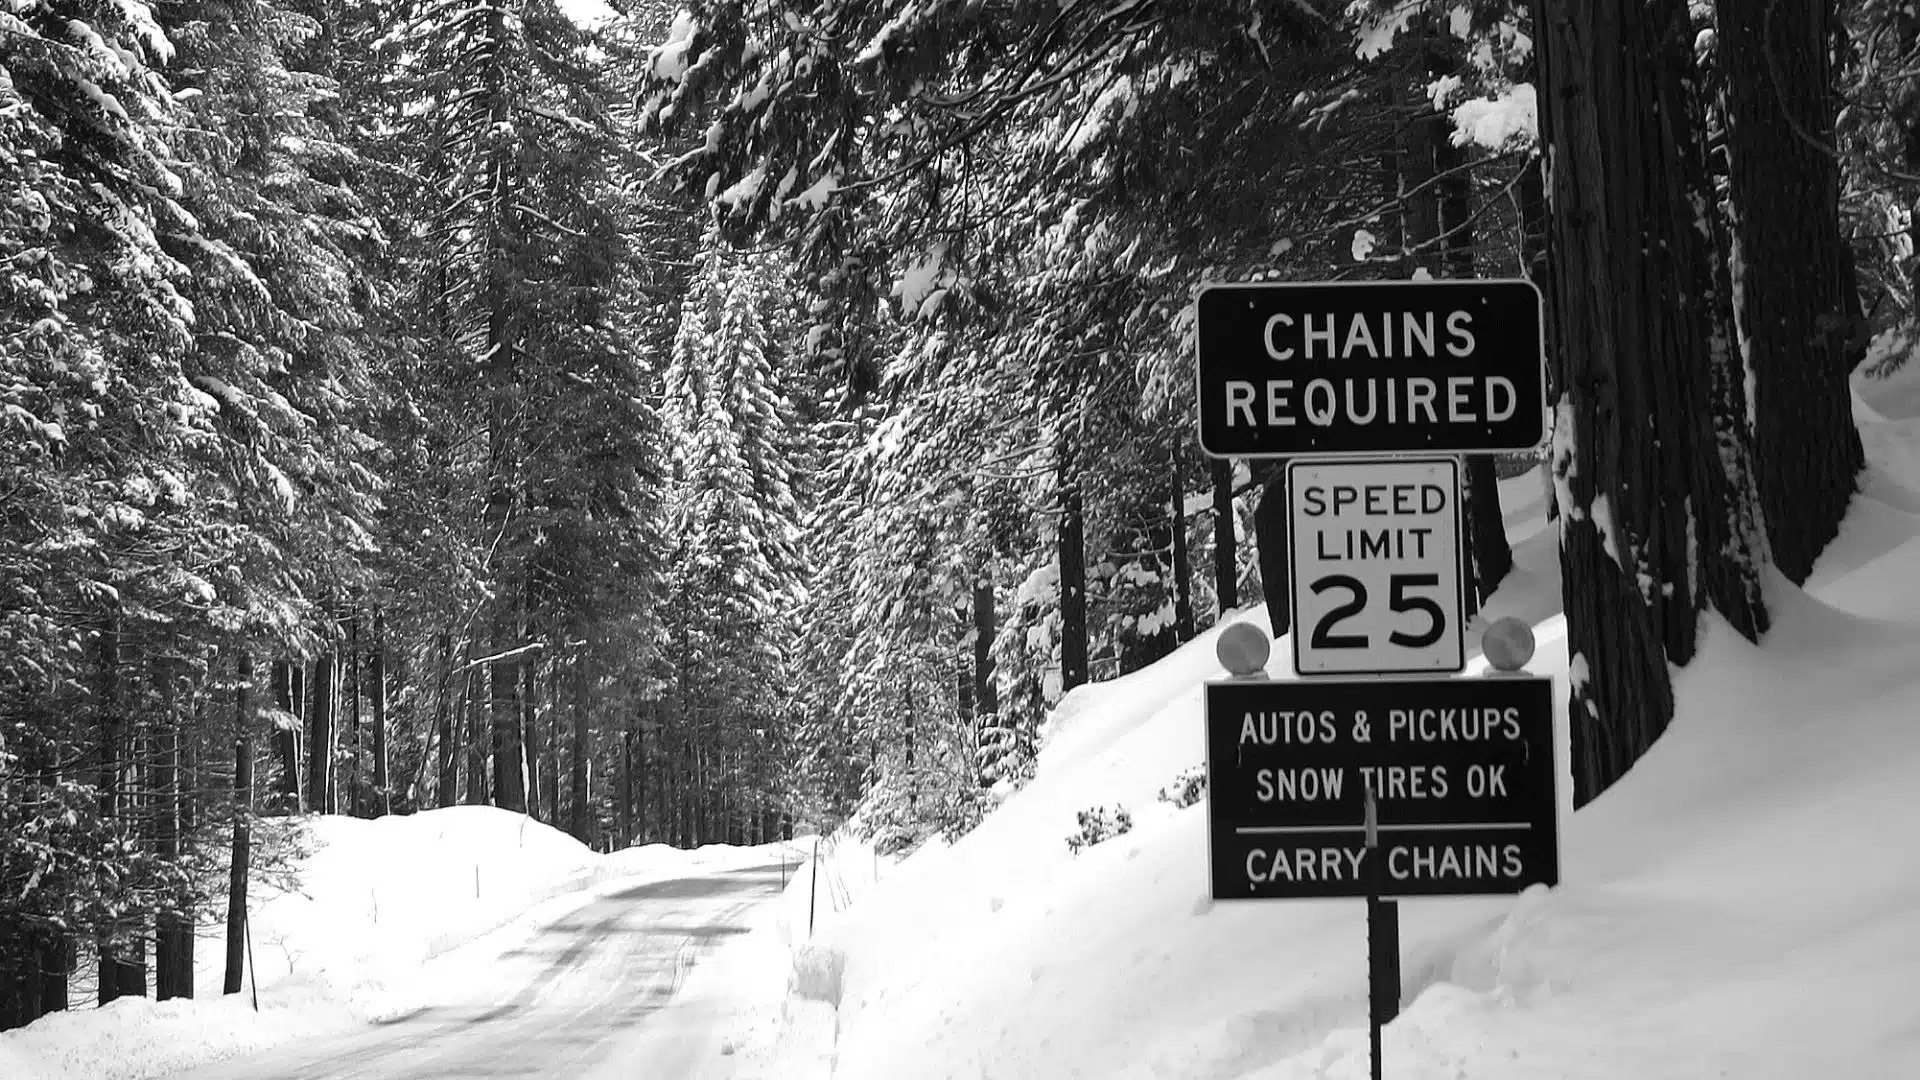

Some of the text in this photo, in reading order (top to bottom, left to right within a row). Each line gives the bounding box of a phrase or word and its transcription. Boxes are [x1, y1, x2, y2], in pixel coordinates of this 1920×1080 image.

[1264, 310, 1476, 361] CHAINS
[1225, 375, 1517, 428] REQUIRED
[1303, 484, 1446, 517] SPEED
[1317, 528, 1433, 561] LIMIT
[1309, 573, 1446, 649] 25
[1239, 707, 1521, 744] AUTOS & PICKUPS
[1256, 764, 1508, 801] SNOW TIRES OK
[1246, 845, 1523, 882] CARRY CHAINS
